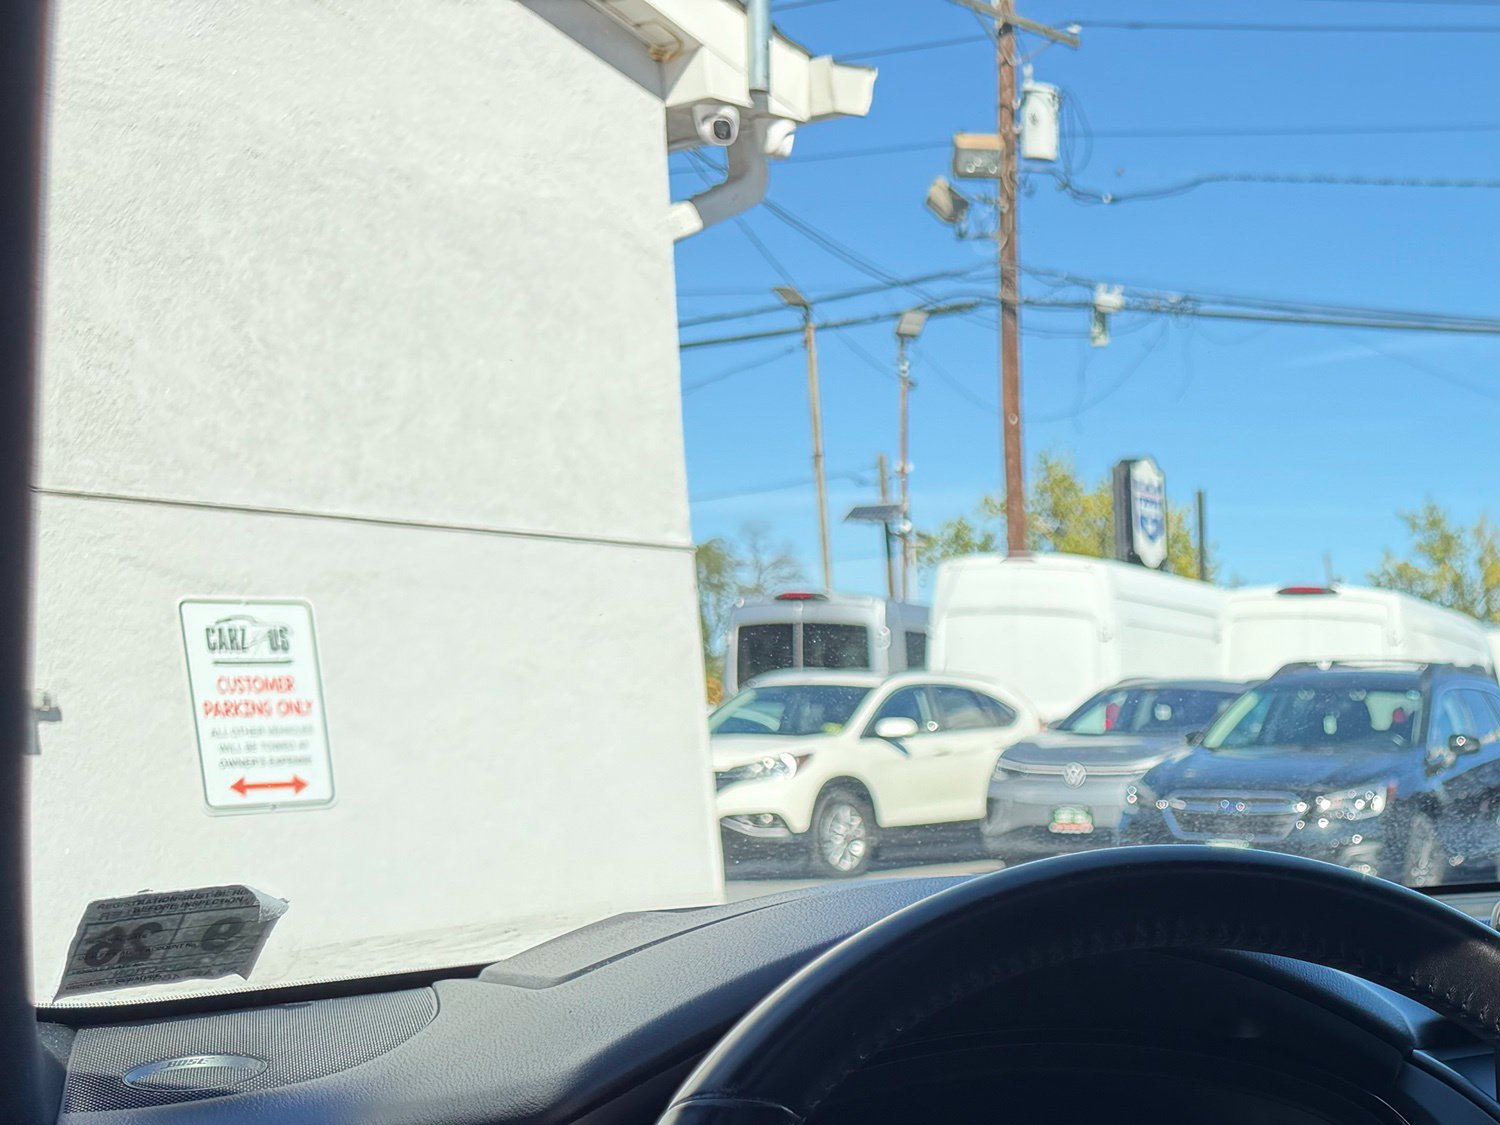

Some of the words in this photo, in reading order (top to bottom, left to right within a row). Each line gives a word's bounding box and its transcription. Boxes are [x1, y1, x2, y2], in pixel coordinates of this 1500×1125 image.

[216, 675, 295, 694] CUSTOMER
[203, 700, 272, 718] PARKING
[277, 699, 314, 717] ONLY
